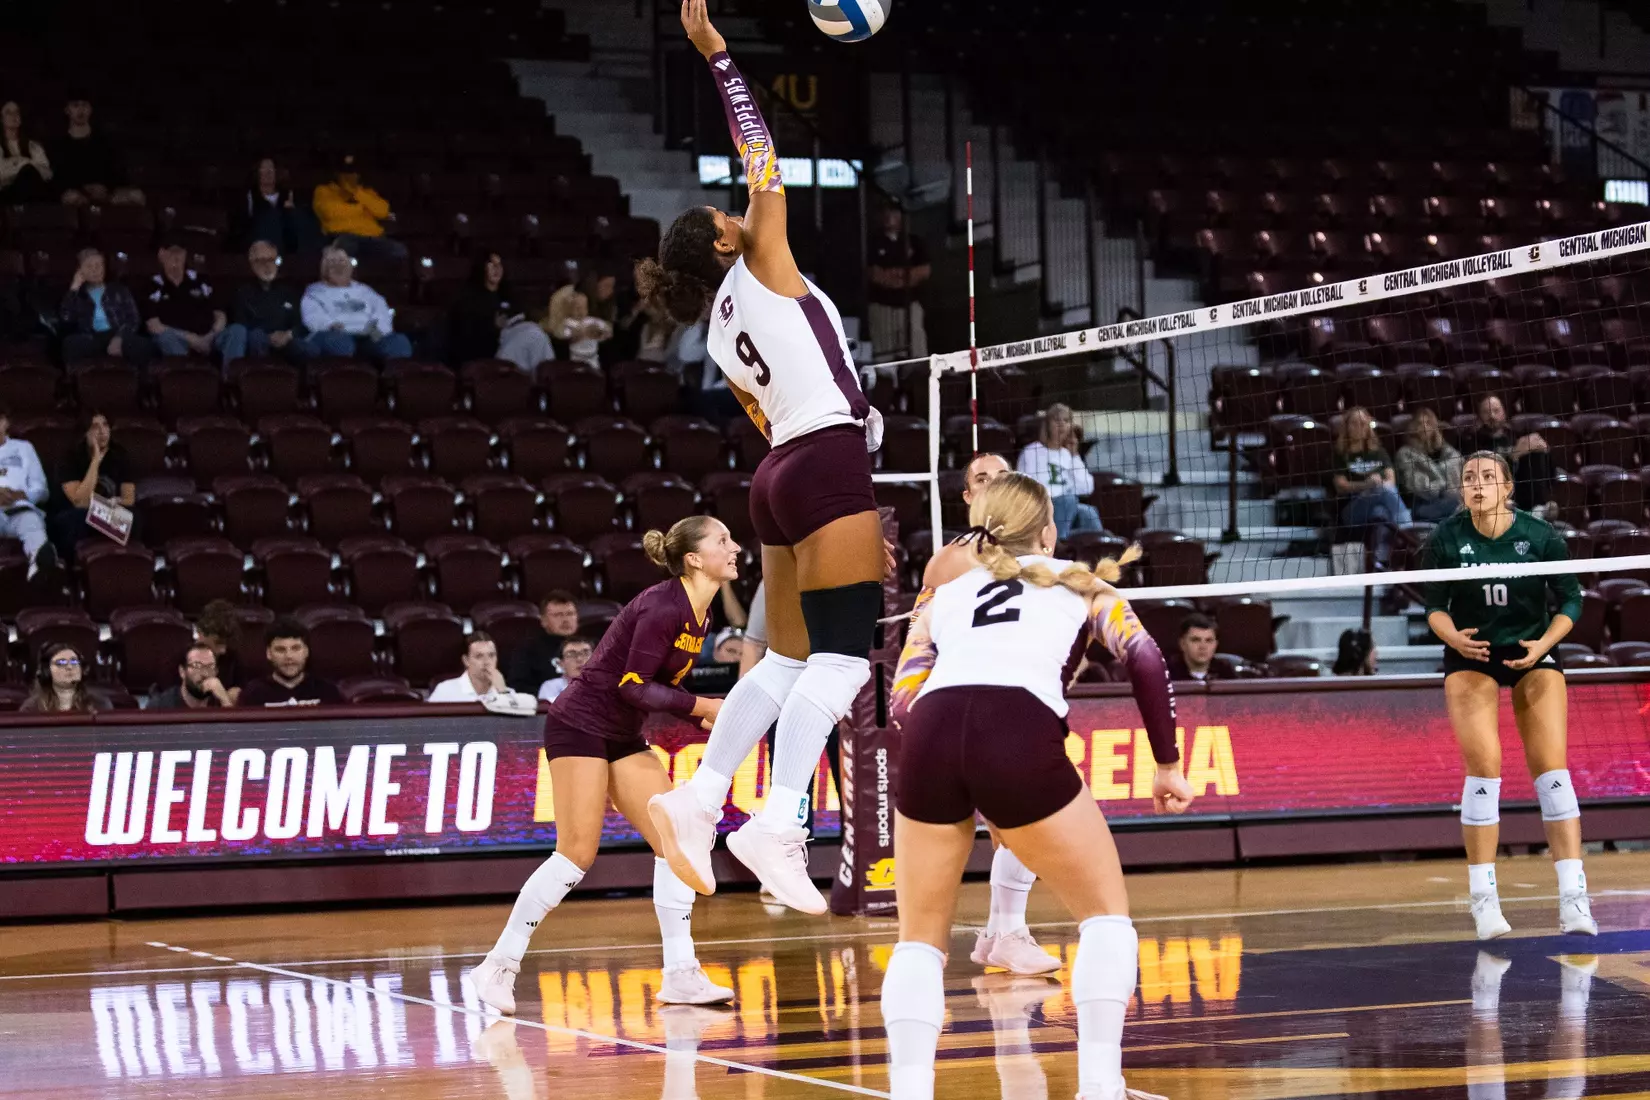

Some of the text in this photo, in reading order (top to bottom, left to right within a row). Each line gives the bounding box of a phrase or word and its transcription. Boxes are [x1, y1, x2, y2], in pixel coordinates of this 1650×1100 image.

[724, 78, 769, 153] CHIPPEWAS
[1559, 224, 1647, 258] CENTRAL MICHIGAN
[1384, 251, 1513, 292] CENTRAL MICHIGAN VOLLEYBALL
[1232, 284, 1344, 319] CENTRAL MICHIGAN VOLLEYBALL
[1098, 311, 1197, 342] CENTRAL MICHIGAN VOLLEYBALL
[736, 331, 771, 387] 9
[981, 334, 1067, 362] CENTRAL MICHIGAN VOLLEYBALL
[972, 577, 1024, 628] 2
[1482, 583, 1508, 606] 10
[84, 743, 407, 846] WELCOME
[423, 741, 498, 833] TO
